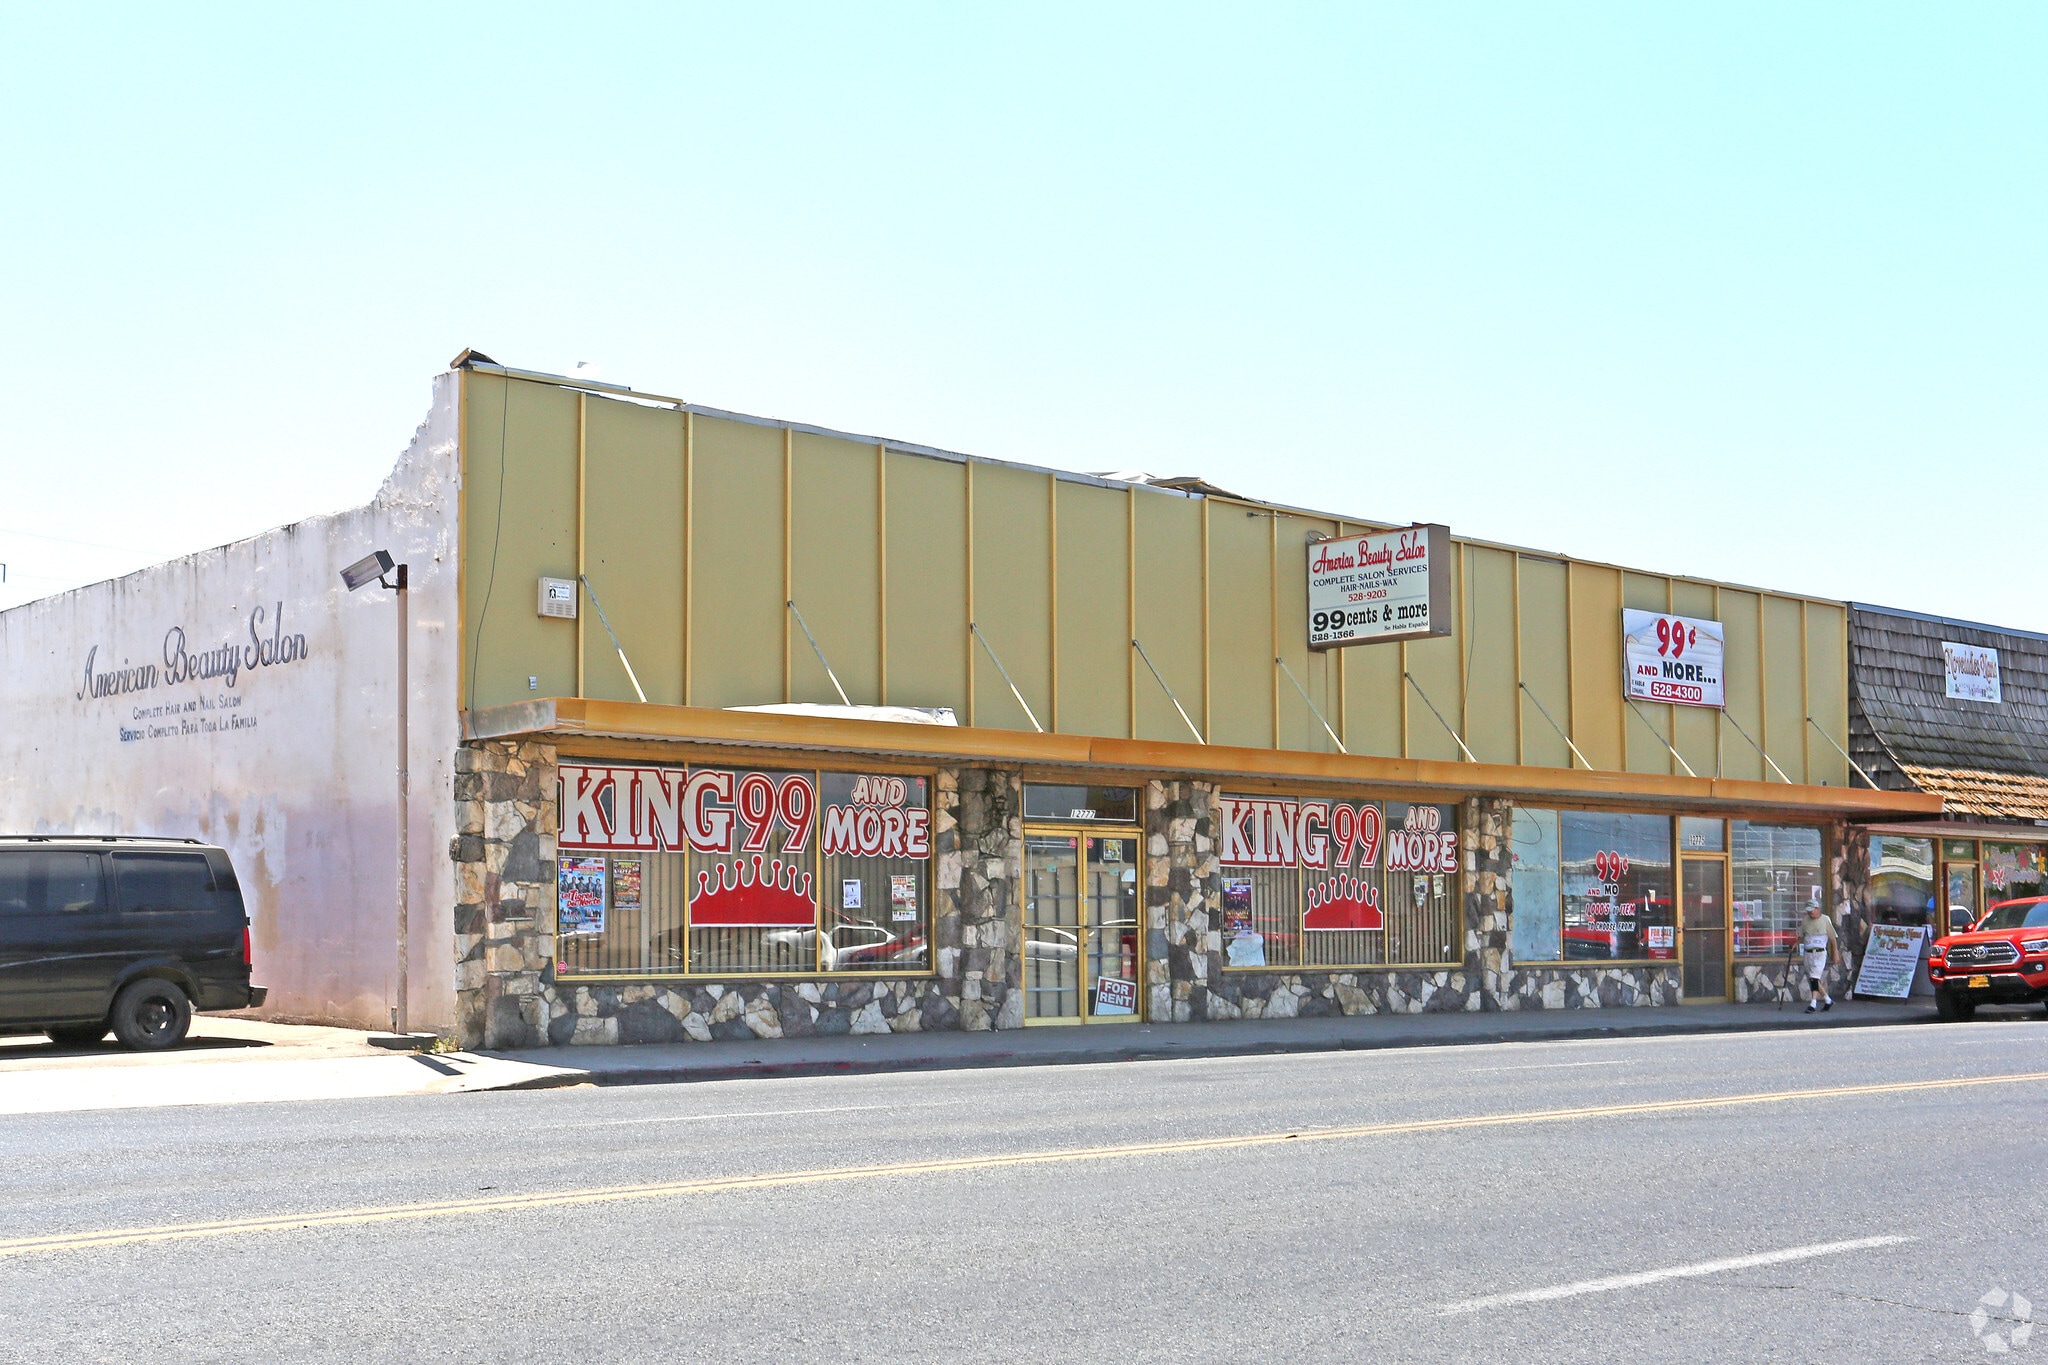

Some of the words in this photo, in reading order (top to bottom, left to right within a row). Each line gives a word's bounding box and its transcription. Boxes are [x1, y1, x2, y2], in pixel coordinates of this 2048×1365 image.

[1312, 546, 1354, 575] America
[1358, 540, 1393, 571] Beauty
[1396, 531, 1426, 562] Salon
[1313, 574, 1355, 587] COMPLETE
[1358, 571, 1385, 581] SALON
[1388, 564, 1427, 577] SERVICES
[1340, 578, 1398, 592] HAIR-NAILS-WAX
[1348, 589, 1387, 602] 528-9203
[1383, 604, 1392, 622] &
[1397, 603, 1427, 619] more
[1311, 630, 1355, 642] 528-1366
[77, 645, 159, 700] American
[163, 625, 241, 688] Beauty
[244, 601, 308, 670] Salon
[1637, 665, 1658, 676] AND
[1662, 661, 1716, 684] MORE...
[1653, 682, 1700, 700] 528-4300
[852, 775, 907, 807] AND
[557, 764, 736, 854] KING
[736, 772, 817, 854] 99
[1071, 809, 1096, 819] 12777
[1404, 806, 1442, 832] AND
[821, 804, 930, 859] MORE
[1219, 798, 1329, 870] KING
[1331, 803, 1384, 869] 99
[1688, 833, 1705, 847] 12775
[1386, 829, 1458, 873] MORE
[1587, 888, 1601, 896] AND
[1604, 883, 1619, 896] MO
[1595, 922, 1617, 931] CHOOSE
[1104, 981, 1129, 995] FOR
[1100, 992, 1132, 1006] RENT
